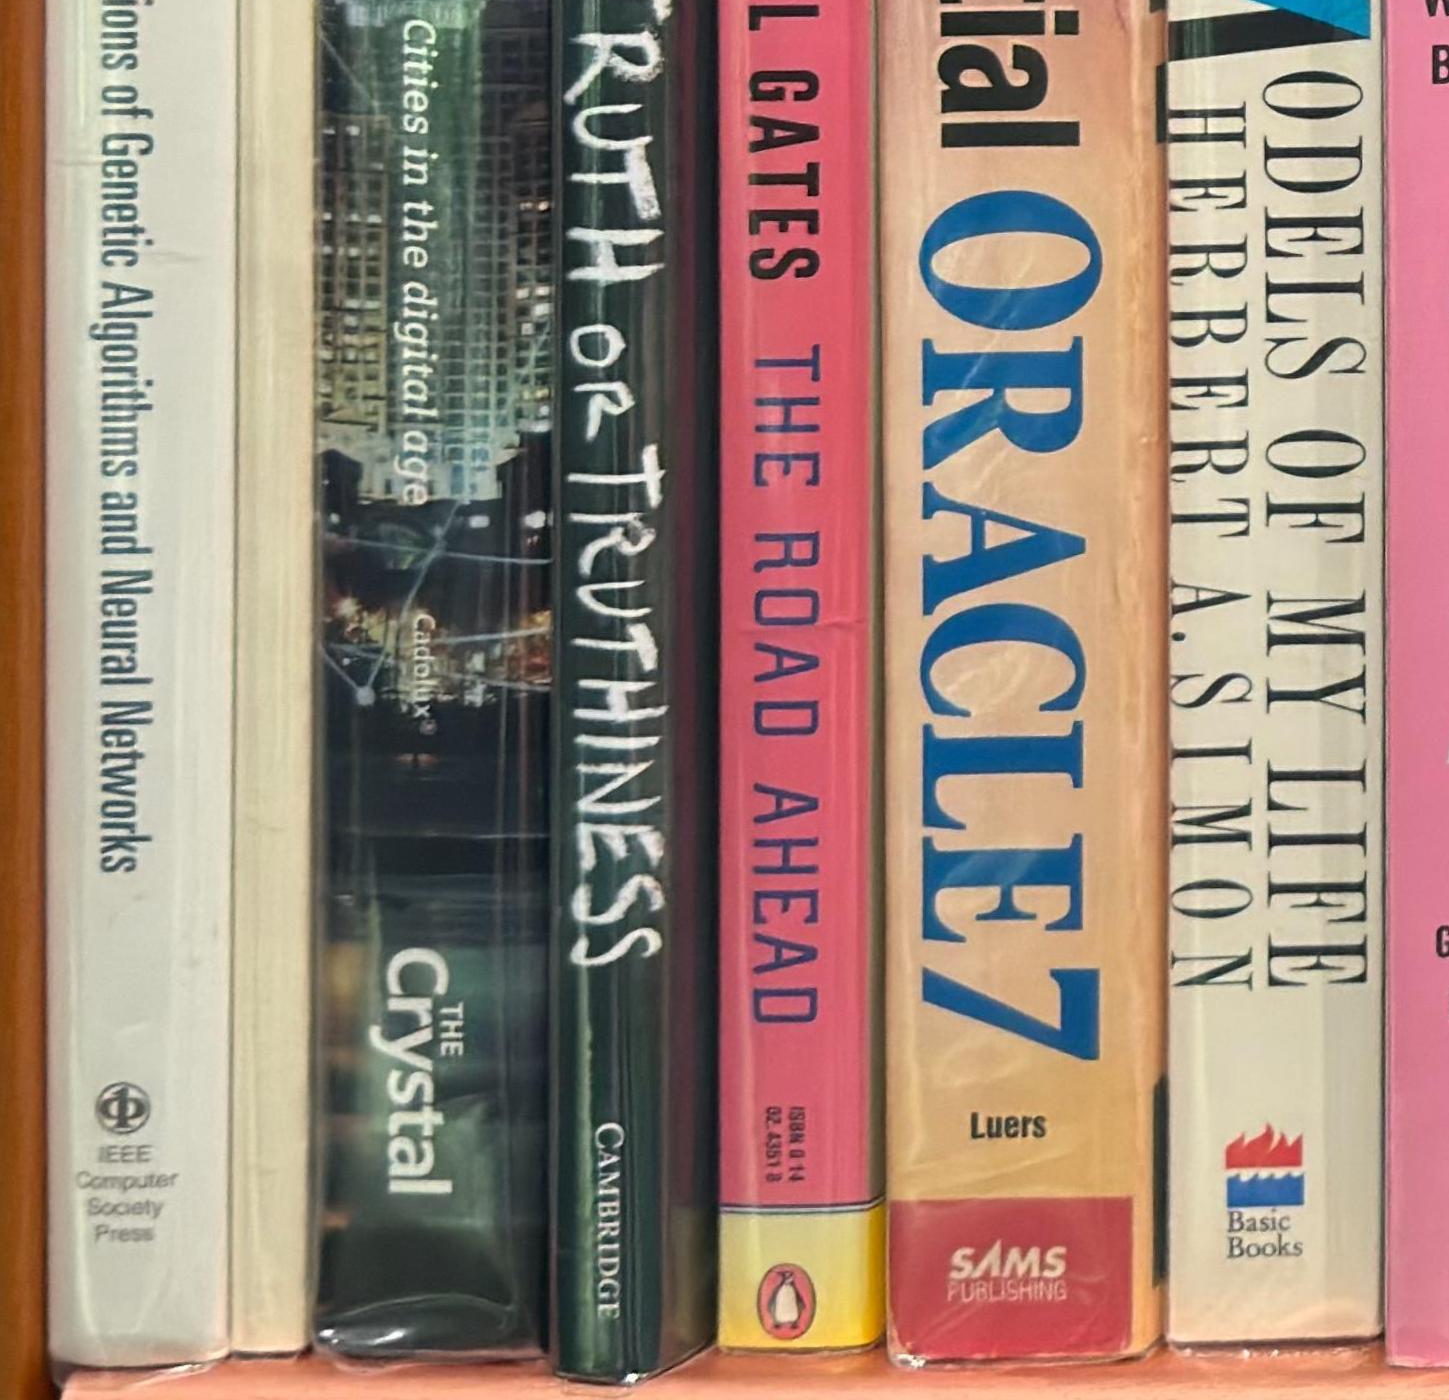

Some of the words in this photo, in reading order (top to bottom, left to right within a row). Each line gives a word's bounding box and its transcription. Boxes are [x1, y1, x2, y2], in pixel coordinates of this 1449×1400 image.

[102, 86, 153, 119] of
[101, 133, 153, 267] Genetic
[749, 70, 819, 280] GATES
[90, 282, 153, 476] Algorithms
[754, 344, 820, 487] THE
[101, 492, 153, 554] and
[100, 570, 153, 685] Neural
[753, 531, 820, 736] ROAD
[100, 701, 153, 873] Networks
[752, 783, 819, 1023] AHEAD
[98, 1145, 152, 1163] IEEE
[970, 1111, 1046, 1141] Luers
[76, 1170, 179, 1192] Computer
[87, 1197, 164, 1219] Society
[595, 1122, 625, 1319] CAMBRIDGE
[1227, 1209, 1291, 1233] Basic
[94, 1224, 154, 1243] Press
[1227, 1235, 1303, 1260] Books
